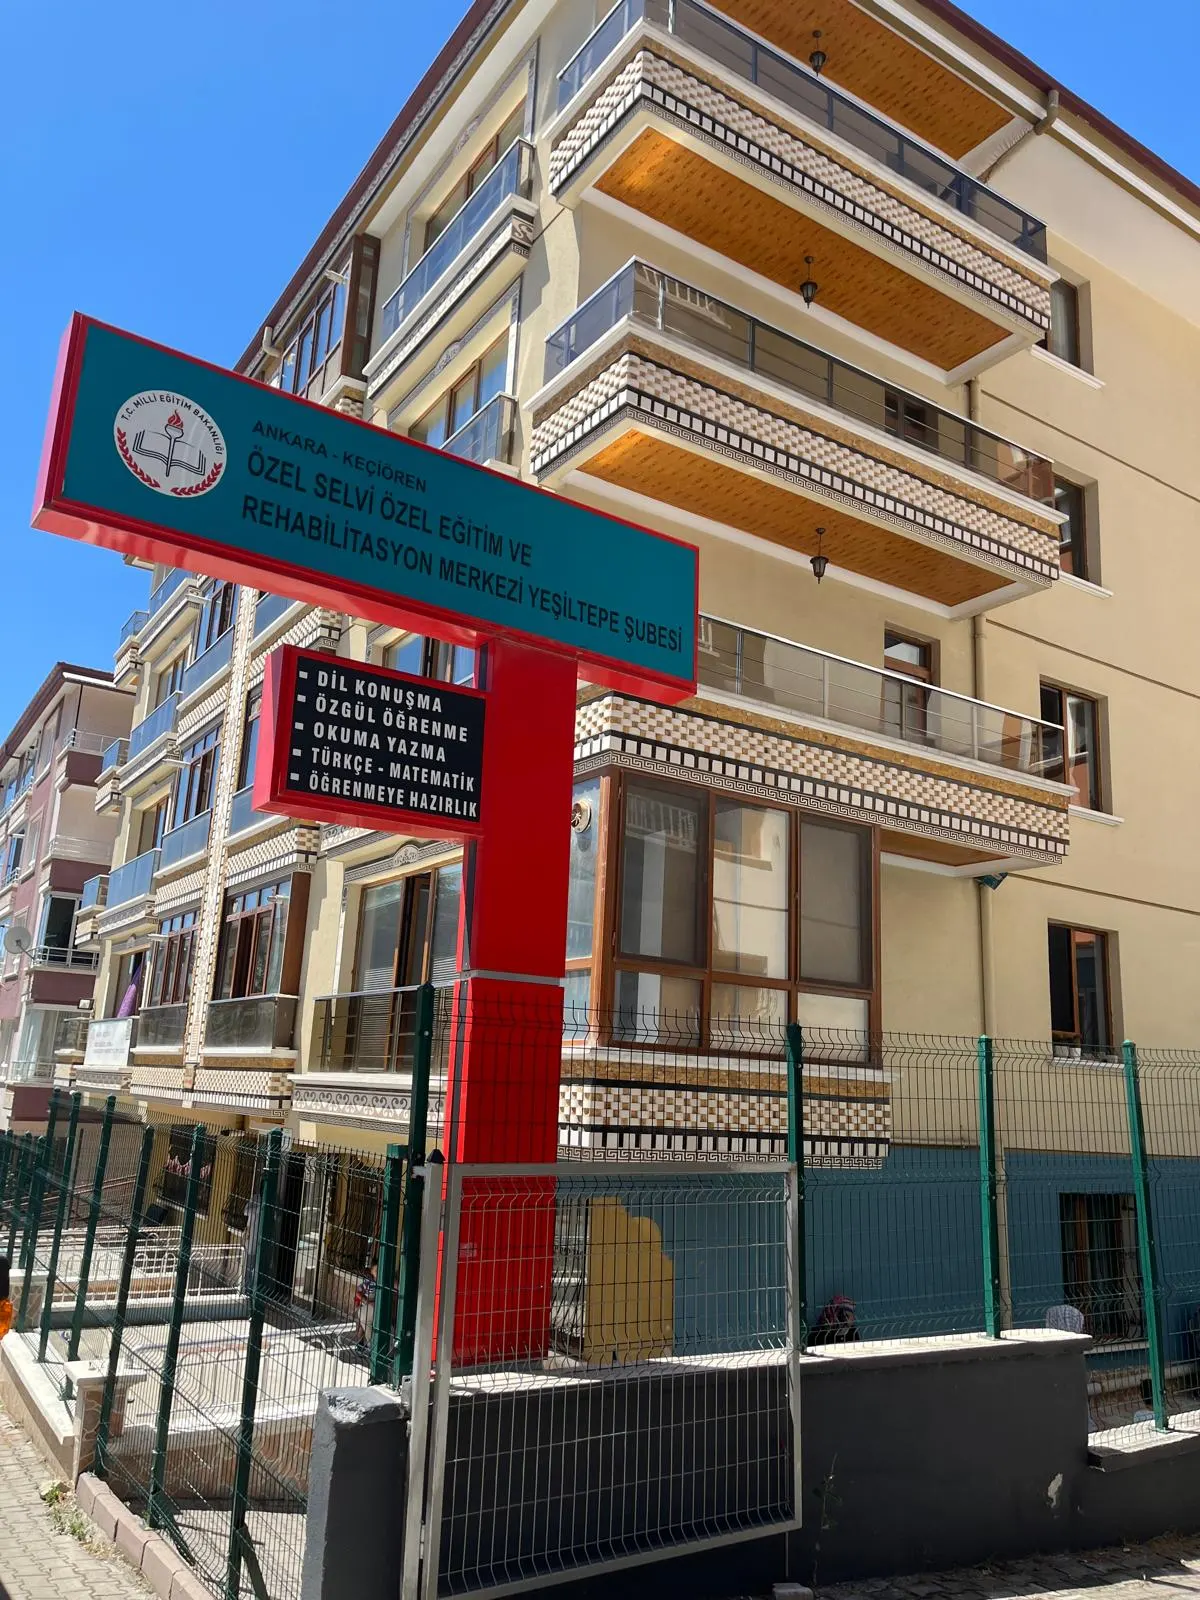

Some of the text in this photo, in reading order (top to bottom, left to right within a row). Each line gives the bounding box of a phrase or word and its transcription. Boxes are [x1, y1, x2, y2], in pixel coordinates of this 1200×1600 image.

[159, 394, 191, 410] EĞİTİM
[193, 409, 224, 455] BAKANLIĞI
[251, 420, 328, 459] ANKARA
[342, 451, 427, 493] KEÇİÖREN
[247, 444, 533, 567] ÖZEL SELVİ ÖZEL EĞİTİM VE
[241, 494, 684, 654] REHABİLİTASYON MERKEZİ YEŞİLTEPE ŞUBESİ
[315, 692, 469, 744] ÖZGÜL ÖĞRENME
[317, 670, 443, 714] DİL KONUŞMA
[313, 721, 447, 764] OKUMA YAZMA
[309, 769, 478, 819] ÖĞRENMEYE HAZIRLIK
[311, 746, 373, 777] TÜRKÇE
[389, 761, 475, 794] MATEMATİK
